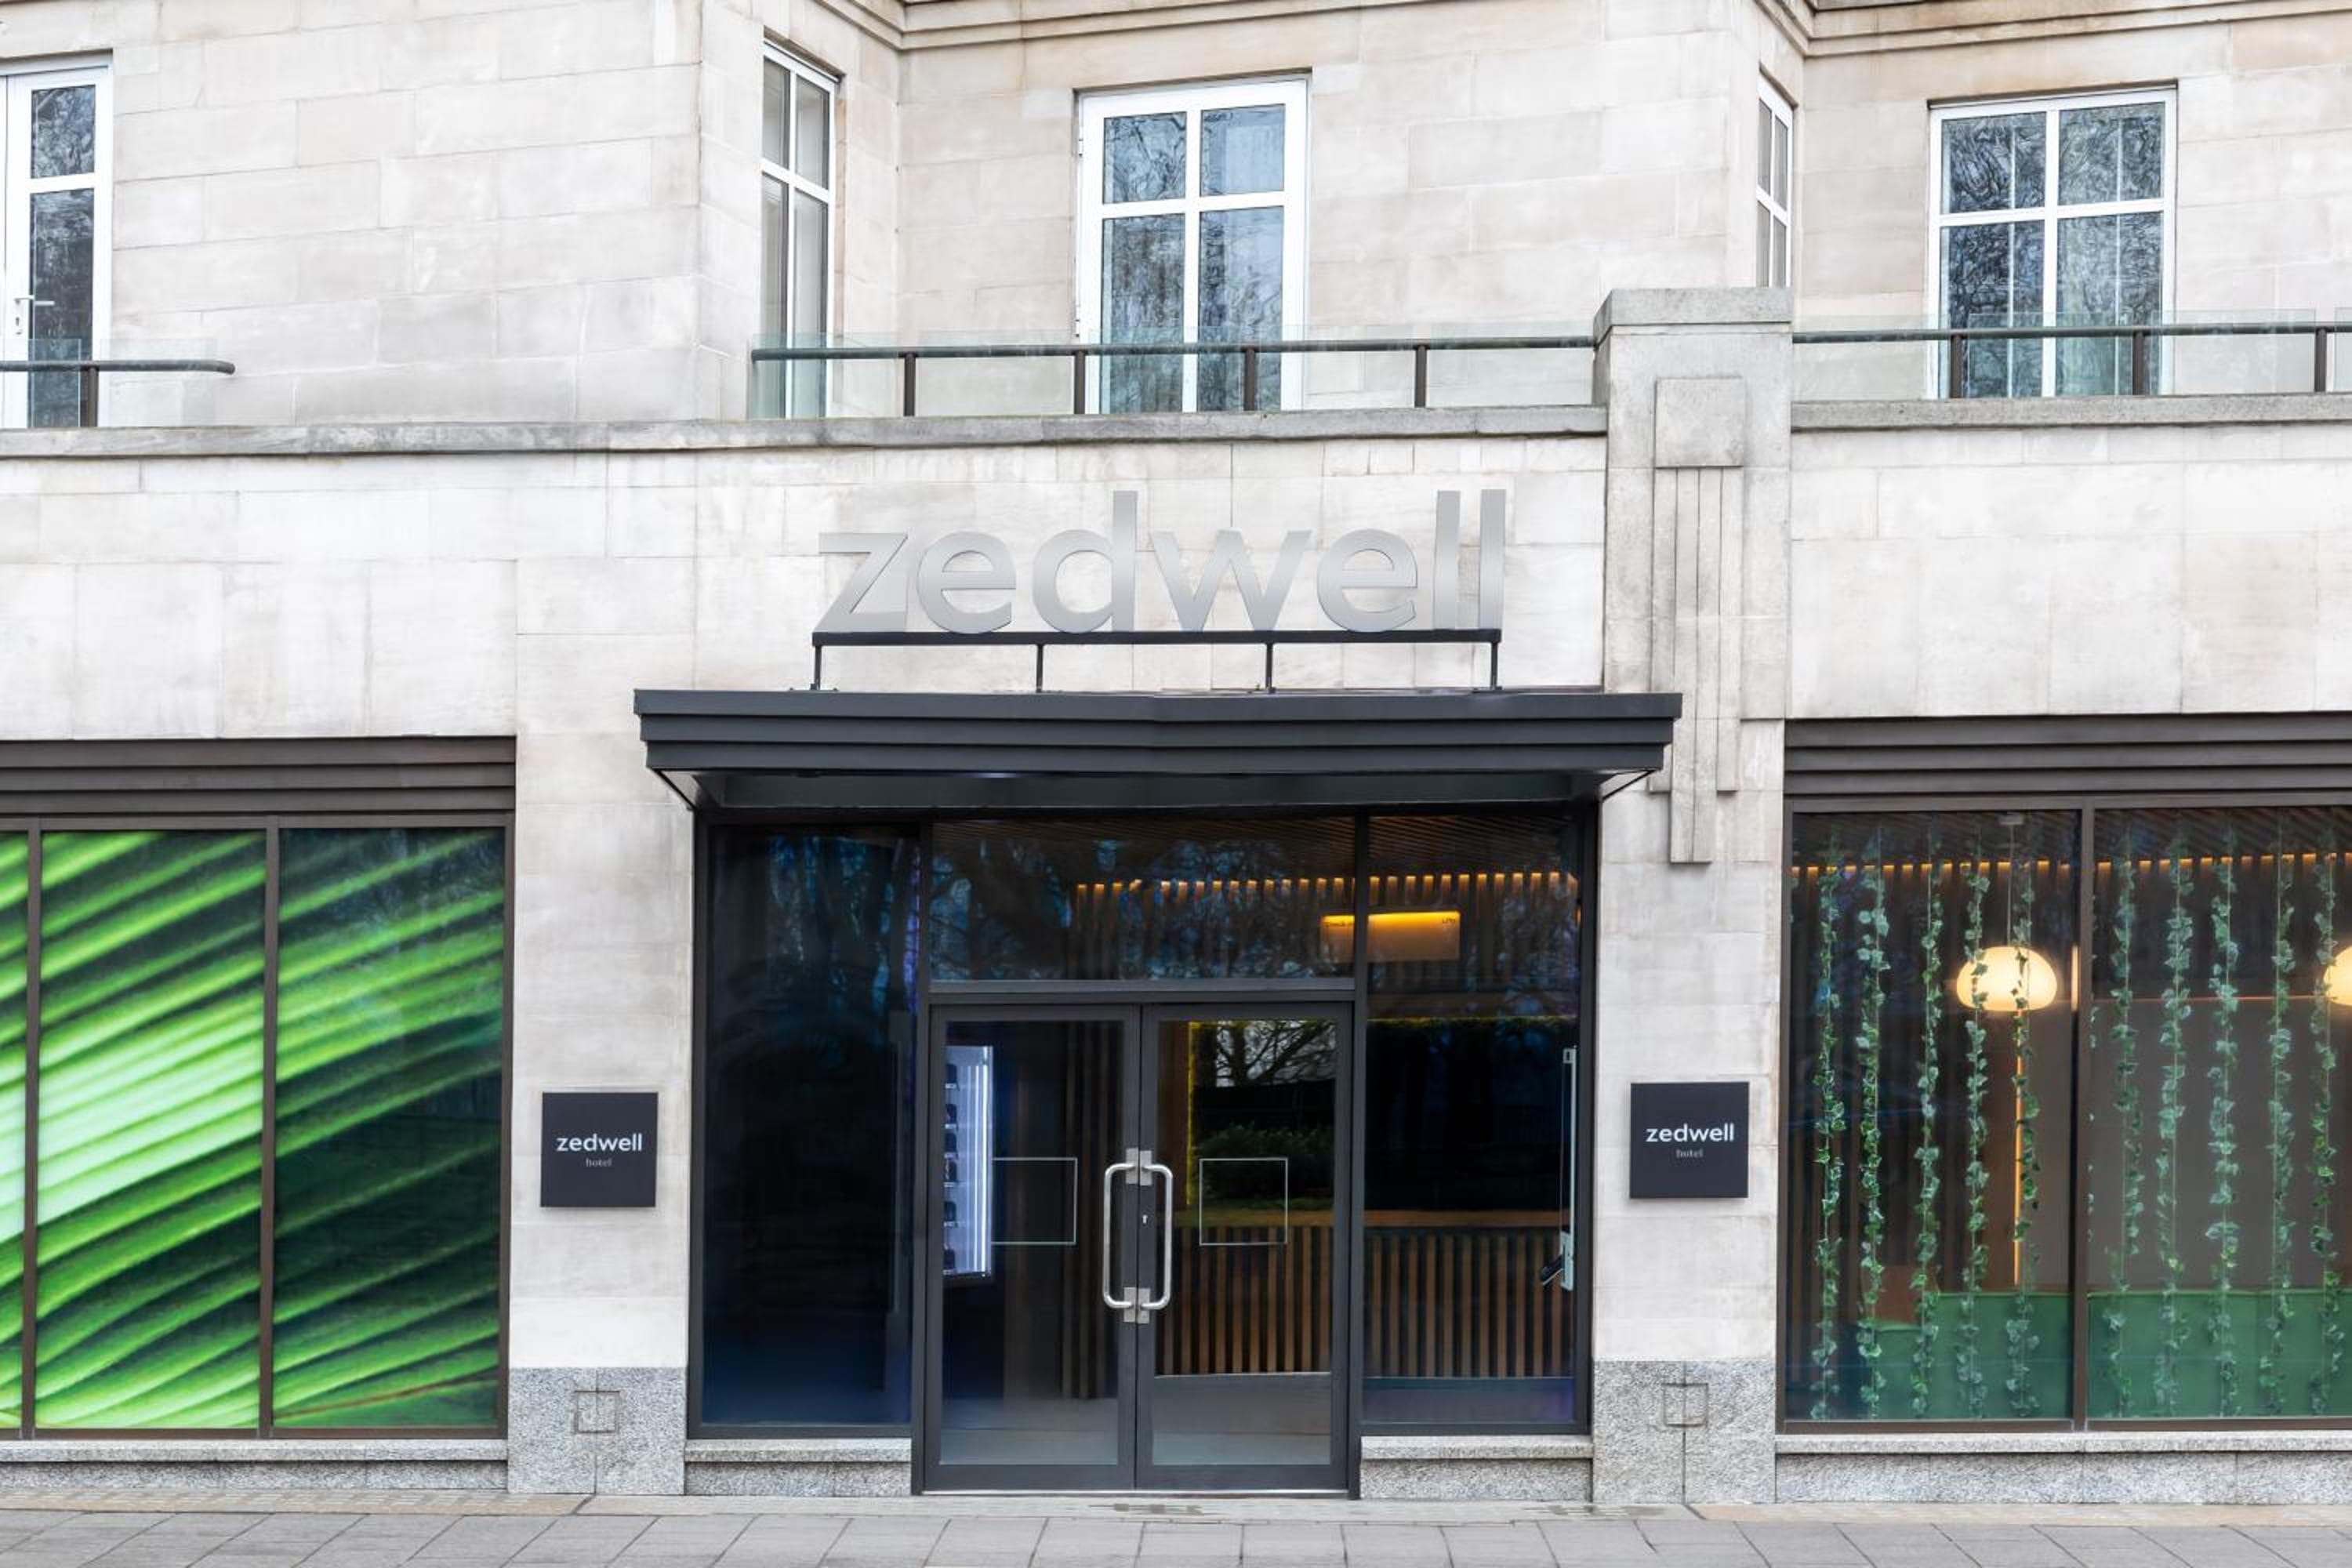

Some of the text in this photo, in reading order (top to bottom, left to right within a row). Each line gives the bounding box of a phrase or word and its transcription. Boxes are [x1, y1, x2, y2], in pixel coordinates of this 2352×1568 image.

[816, 489, 1507, 633] zedwell
[556, 1133, 642, 1151] zedwell
[1646, 1123, 1734, 1142] zedwell
